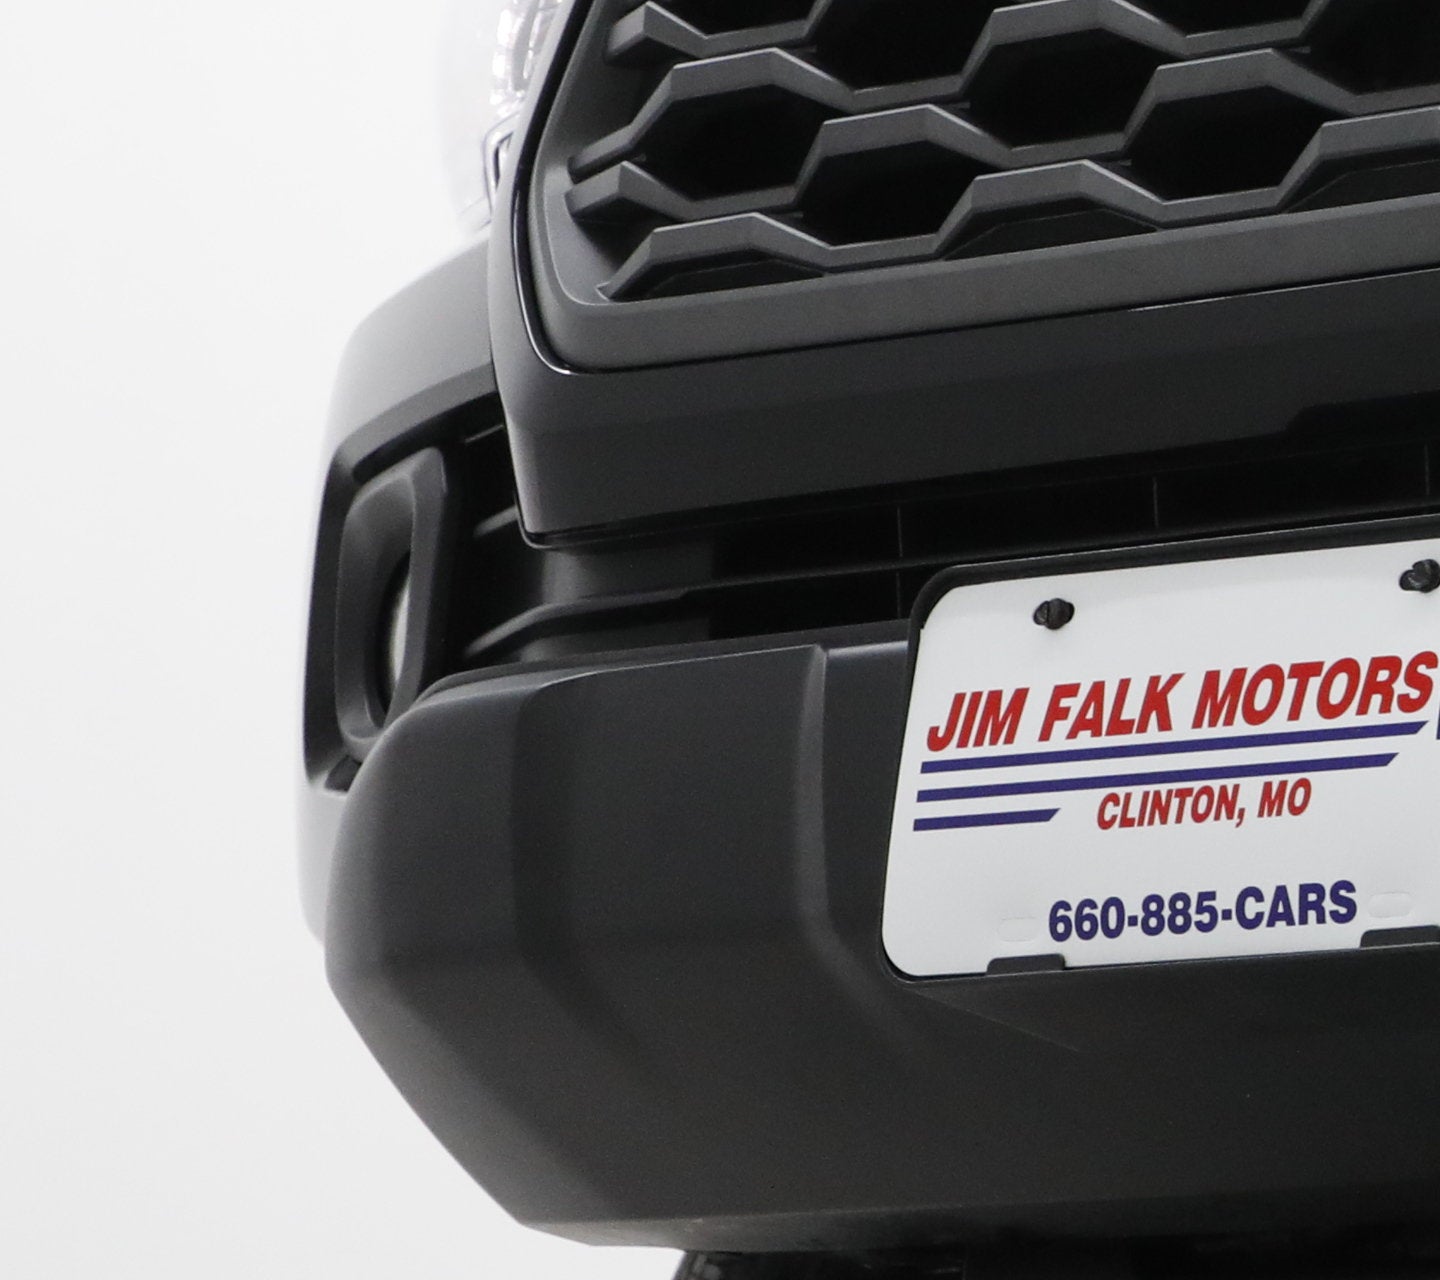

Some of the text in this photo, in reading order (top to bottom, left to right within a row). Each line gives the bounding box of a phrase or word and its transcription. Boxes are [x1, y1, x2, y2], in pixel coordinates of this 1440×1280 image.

[926, 651, 1439, 752] JIM FALK MOTORS
[1097, 778, 1311, 830] CLINTON, MO
[1049, 880, 1357, 941] 660-885-CARS
